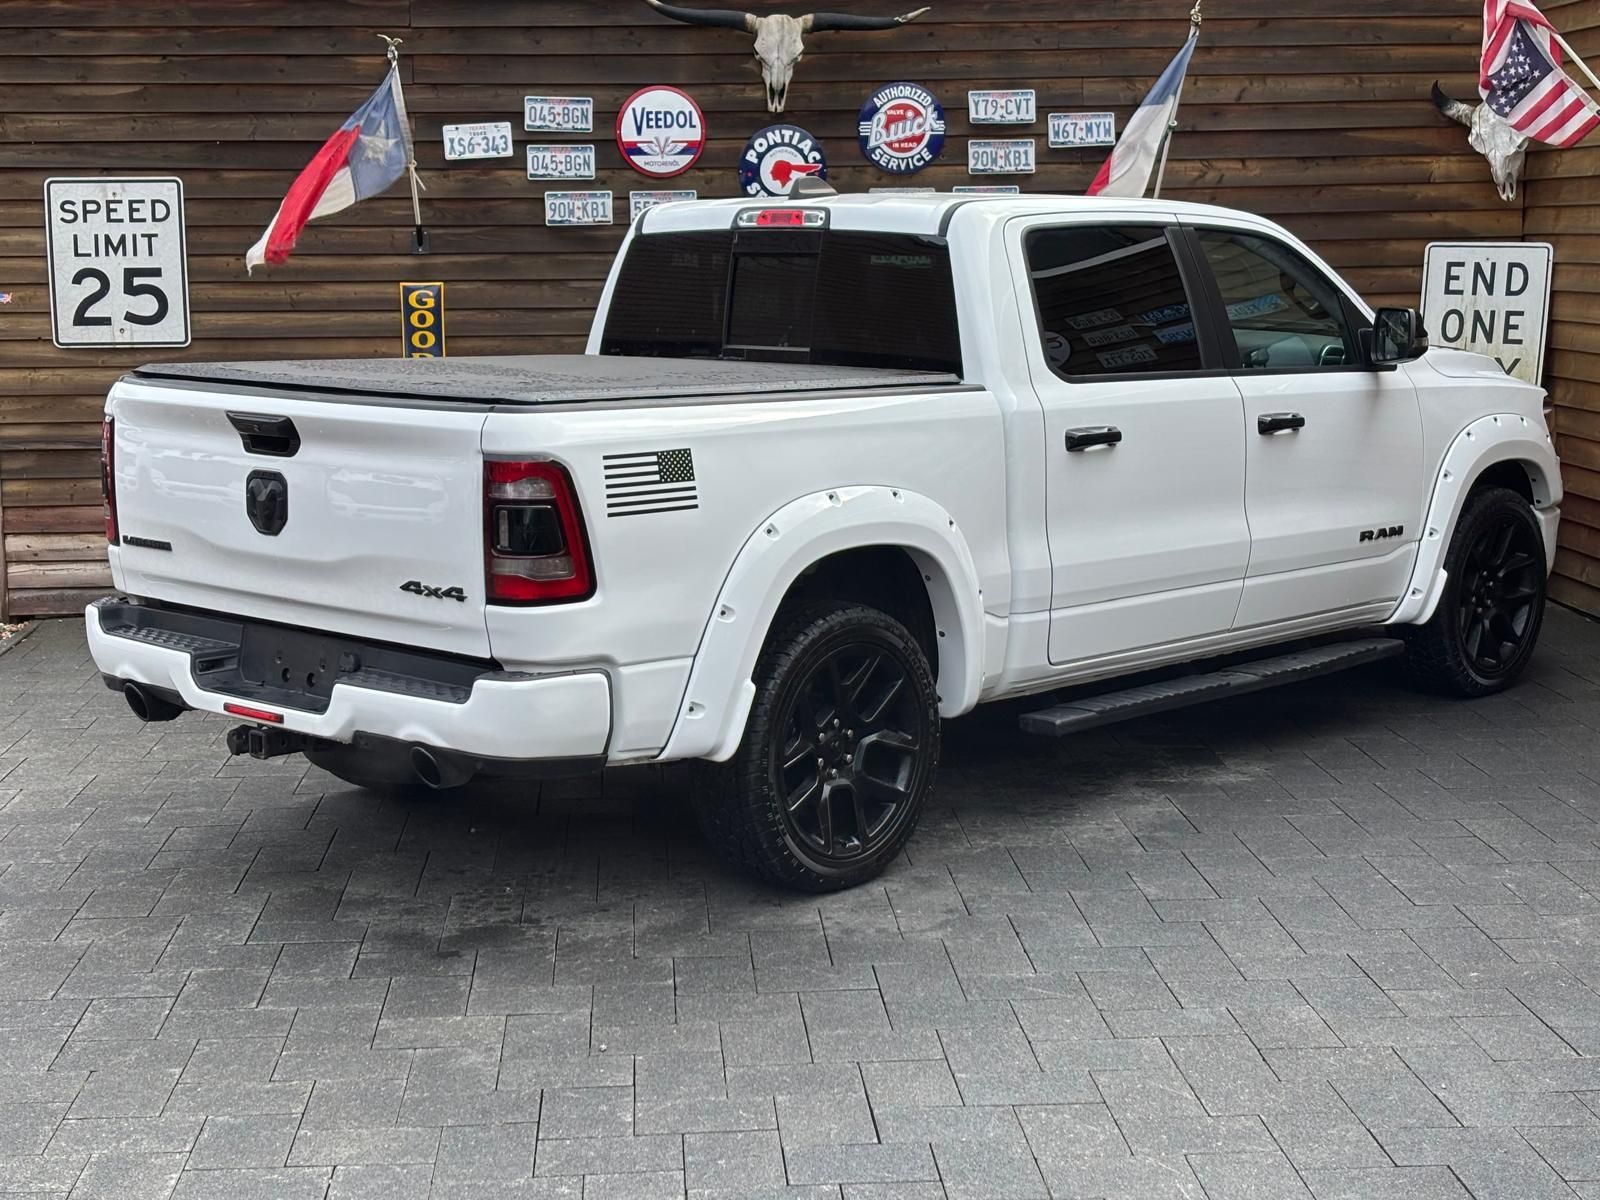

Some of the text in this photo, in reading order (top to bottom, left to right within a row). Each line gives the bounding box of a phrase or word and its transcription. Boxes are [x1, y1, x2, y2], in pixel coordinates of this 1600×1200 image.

[873, 85, 932, 108] AUTHORIZED
[632, 107, 697, 136] VEEDOL
[867, 104, 946, 149] Buick
[745, 129, 821, 164] PONTIAC
[871, 147, 933, 171] SERVICE
[59, 199, 170, 224] SPEED
[73, 233, 158, 257] LIMIT
[1444, 261, 1529, 296] END
[71, 267, 169, 326] 25
[408, 289, 436, 359] GOO
[1441, 309, 1525, 345] ONE
[1359, 525, 1403, 542] RAM
[399, 580, 468, 602] 4x4
